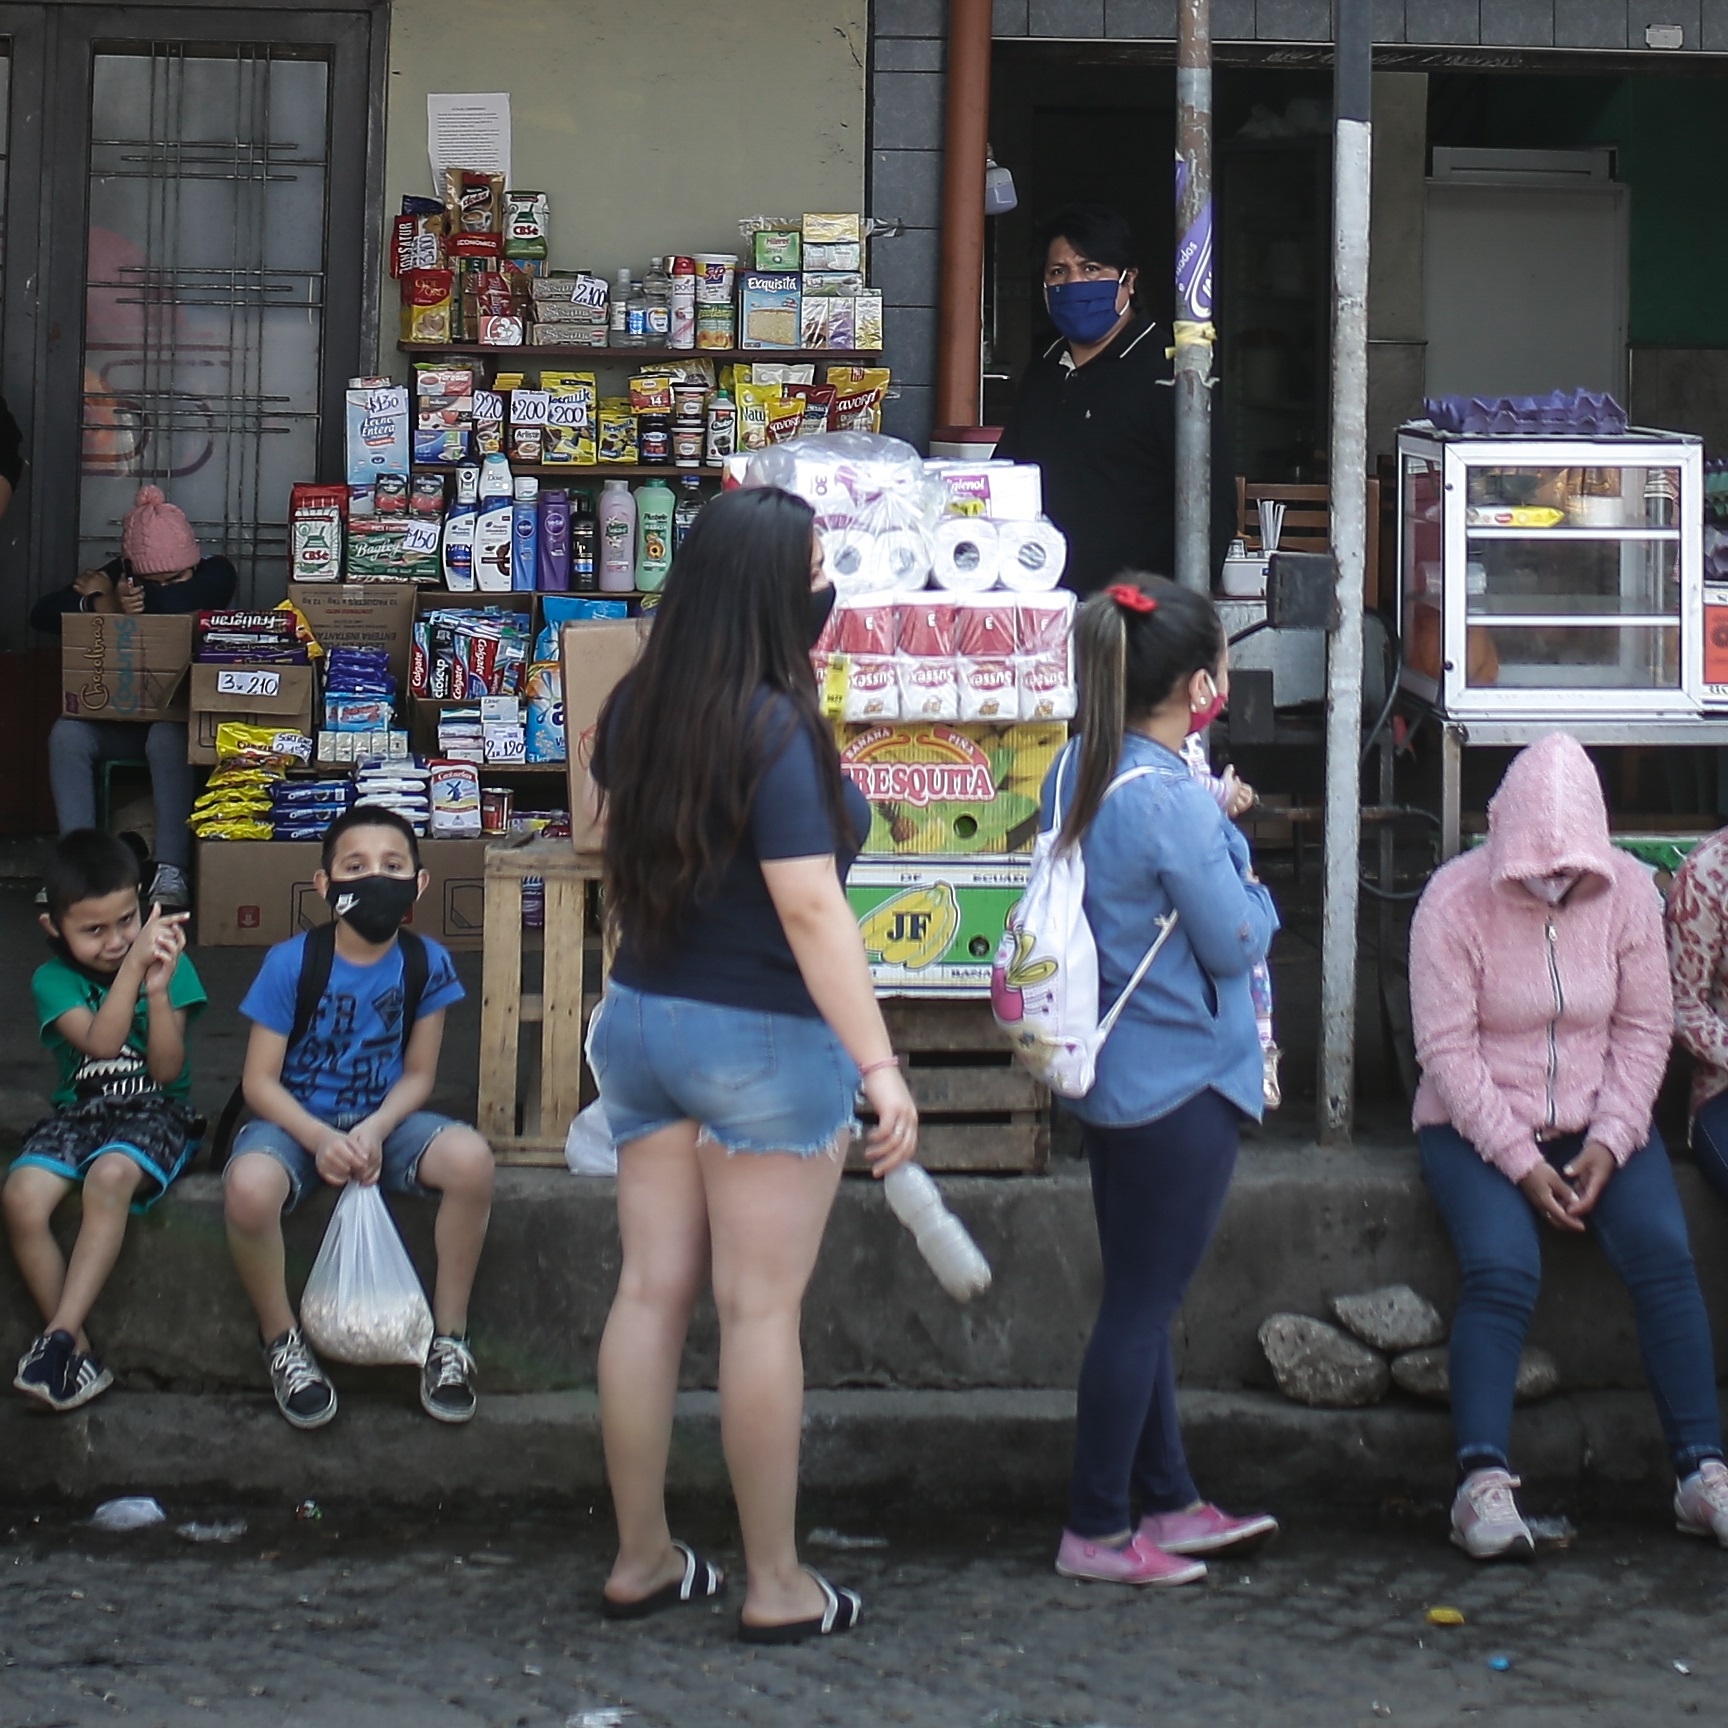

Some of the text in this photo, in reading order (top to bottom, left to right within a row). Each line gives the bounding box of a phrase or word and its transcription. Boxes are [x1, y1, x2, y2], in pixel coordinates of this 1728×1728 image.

[536, 280, 573, 293] Sesam
[512, 399, 546, 420] $200
[741, 408, 765, 421] Natu
[362, 425, 395, 437] Entera
[355, 539, 400, 562] Bagley
[313, 632, 360, 642] INSTANTA
[412, 651, 424, 688] Colgate
[434, 658, 449, 699] closeup
[247, 677, 278, 694] 210
[453, 664, 464, 700] Colgate
[846, 727, 973, 759] BANANA PIÑA
[973, 874, 1029, 883] ECUAD
[887, 912, 932, 940] JF
[951, 969, 992, 978] BANA
